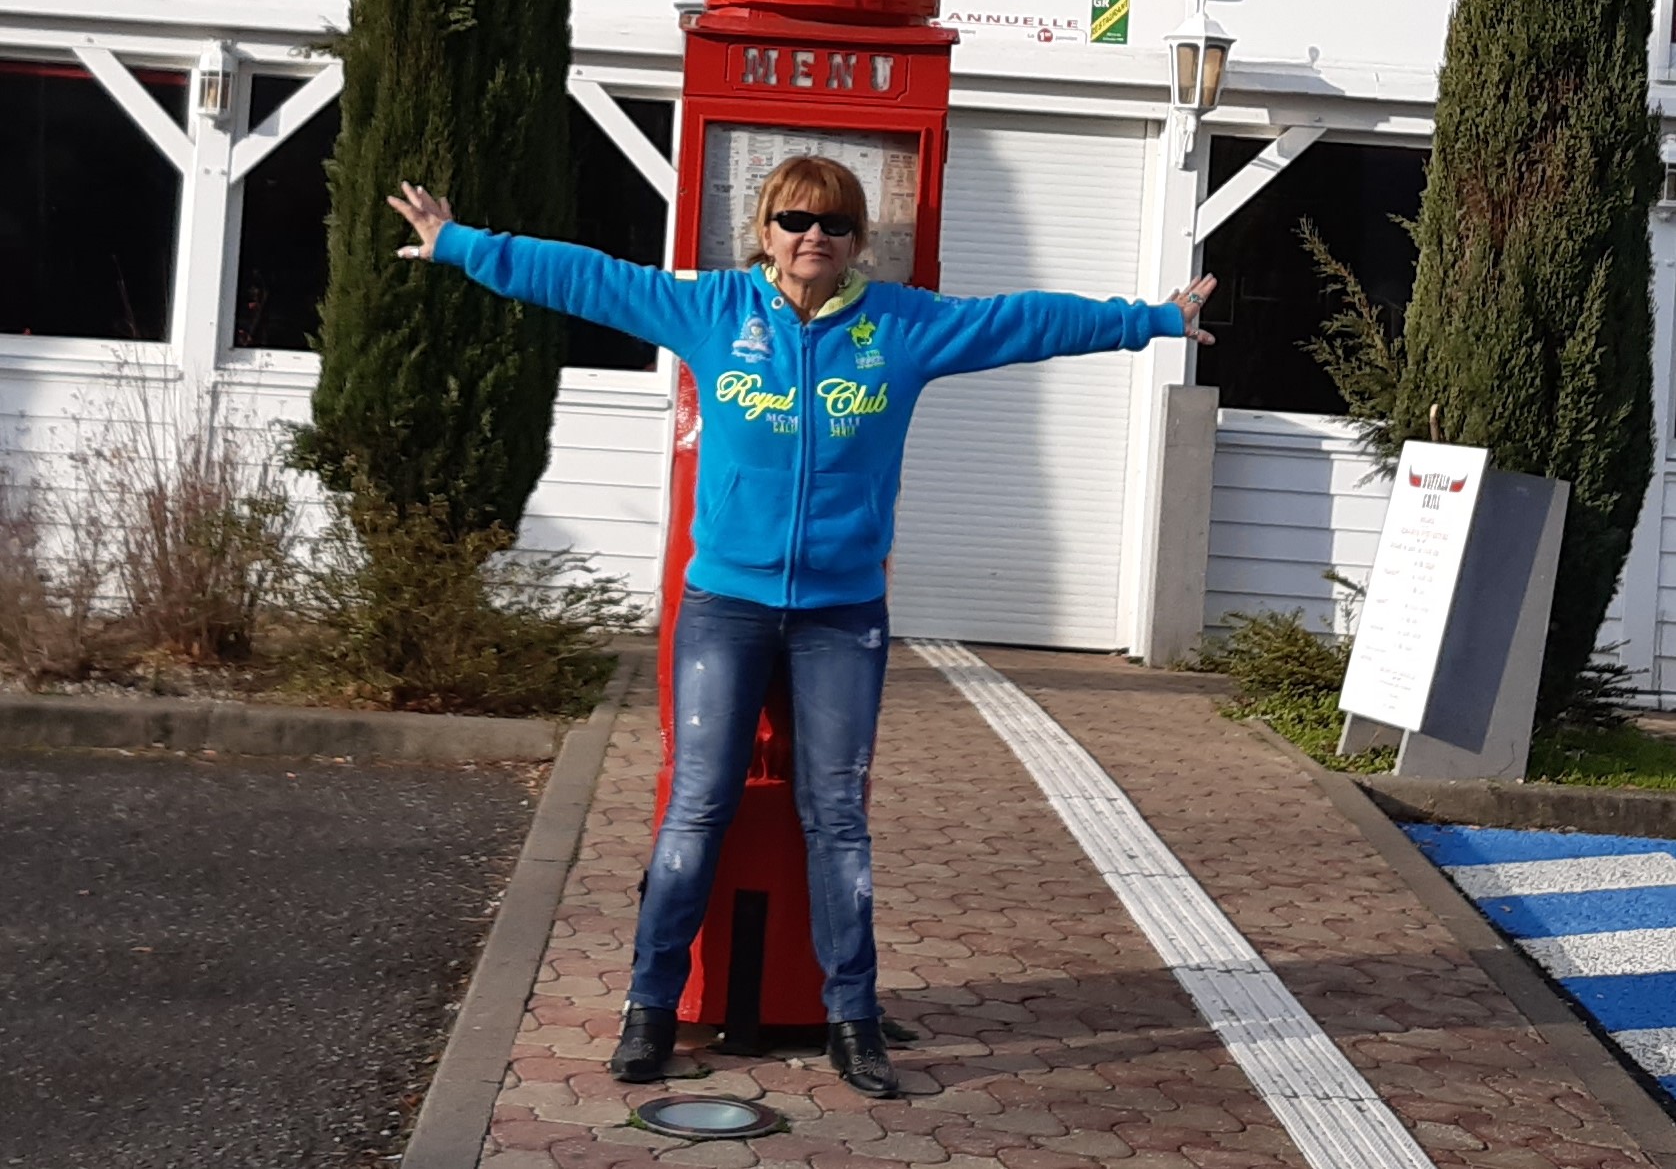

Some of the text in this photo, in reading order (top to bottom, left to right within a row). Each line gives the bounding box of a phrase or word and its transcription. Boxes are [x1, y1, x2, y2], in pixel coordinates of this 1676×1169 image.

[947, 12, 1079, 29] ANNUELLE
[742, 47, 894, 93] MENU
[716, 370, 889, 421] Royal Club
